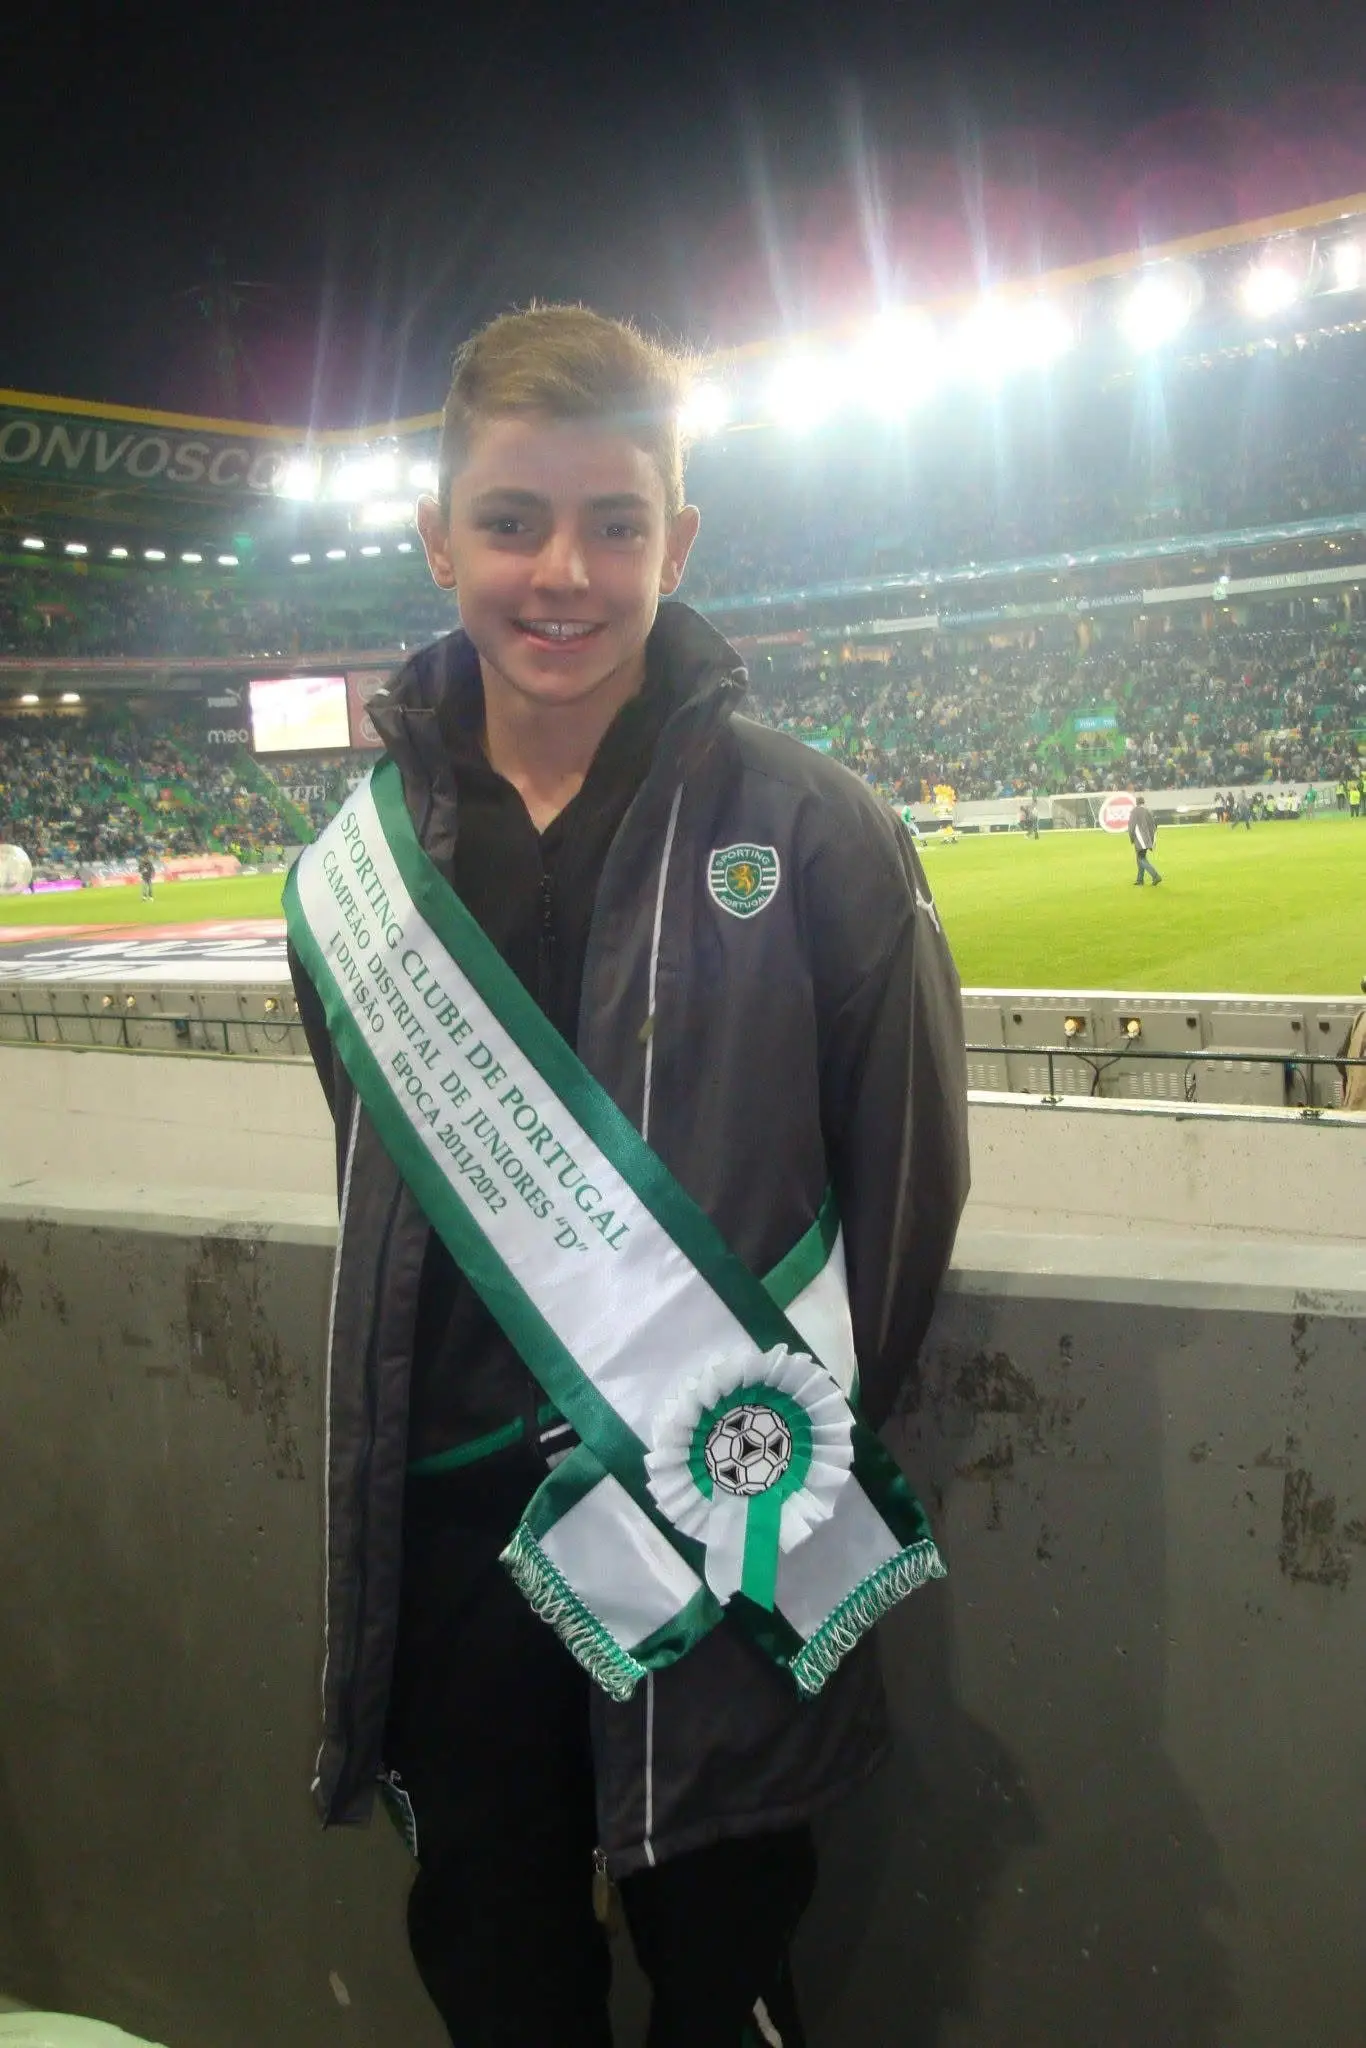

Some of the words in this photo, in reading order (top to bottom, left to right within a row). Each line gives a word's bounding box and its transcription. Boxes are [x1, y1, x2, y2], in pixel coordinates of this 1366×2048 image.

[207, 728, 249, 744] meo
[715, 848, 771, 867] SPORTING
[323, 850, 371, 950] CAMPEÃO
[367, 952, 442, 1070] DISTRITAL
[439, 1070, 472, 1109] DE
[461, 1107, 555, 1219] JUNIORES
[330, 930, 342, 947] I
[336, 943, 384, 1033] DIVISÃO
[391, 1051, 440, 1128] ÉPOCA
[436, 1123, 508, 1215] 2011/2012
[341, 811, 404, 950] SPORTING
[401, 950, 474, 1046] CLUBE
[464, 1040, 508, 1090] DE
[498, 1085, 631, 1251] PORTUGAL
